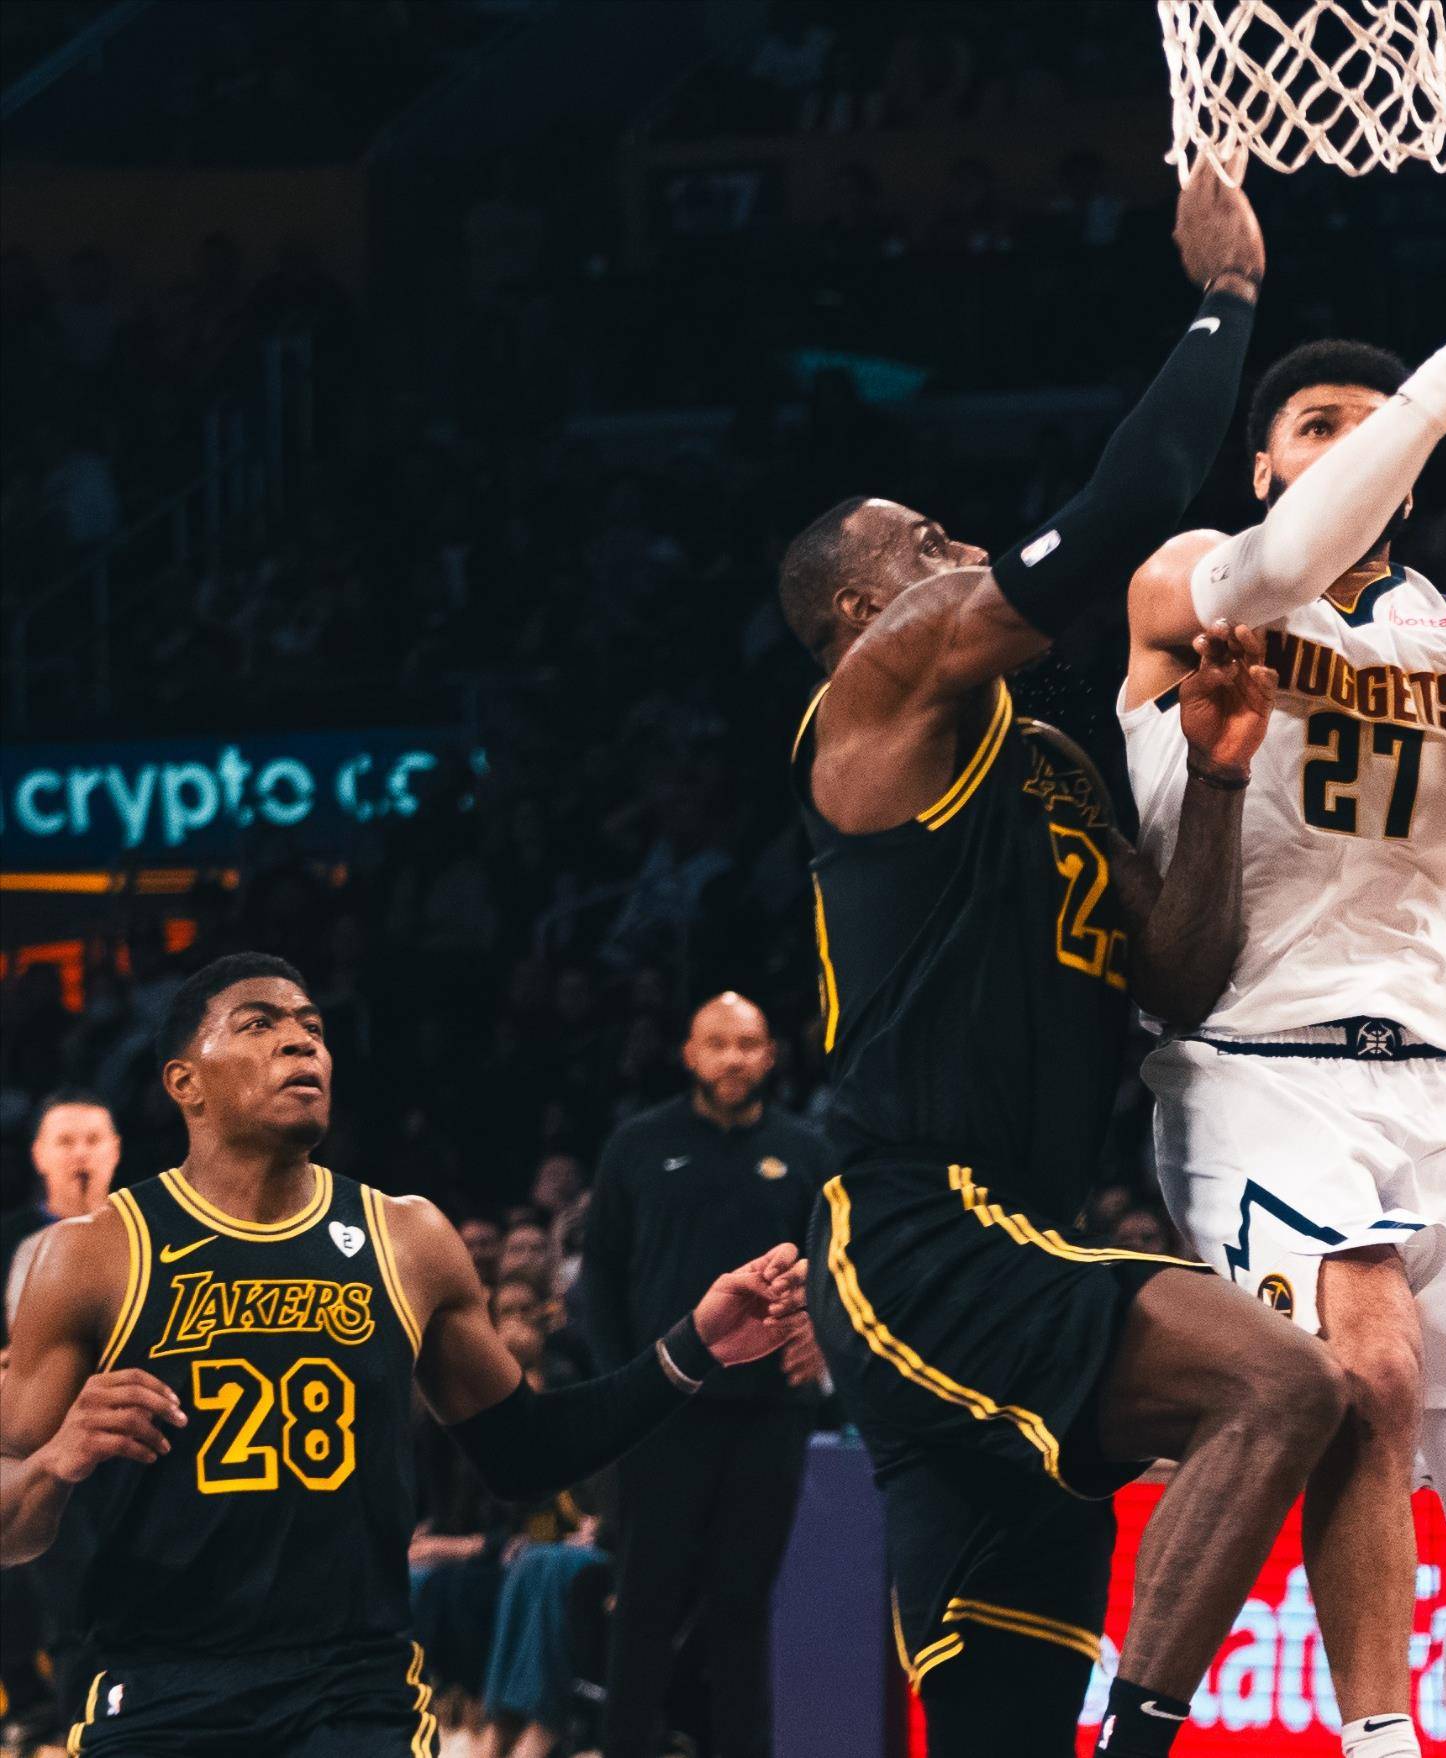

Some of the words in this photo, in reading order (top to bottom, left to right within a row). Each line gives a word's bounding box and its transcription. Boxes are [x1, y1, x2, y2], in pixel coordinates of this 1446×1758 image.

[1301, 709, 1426, 840] 27
[1048, 820, 1128, 988] 2
[149, 1270, 375, 1358] LAKERS
[191, 1357, 356, 1494] 28
